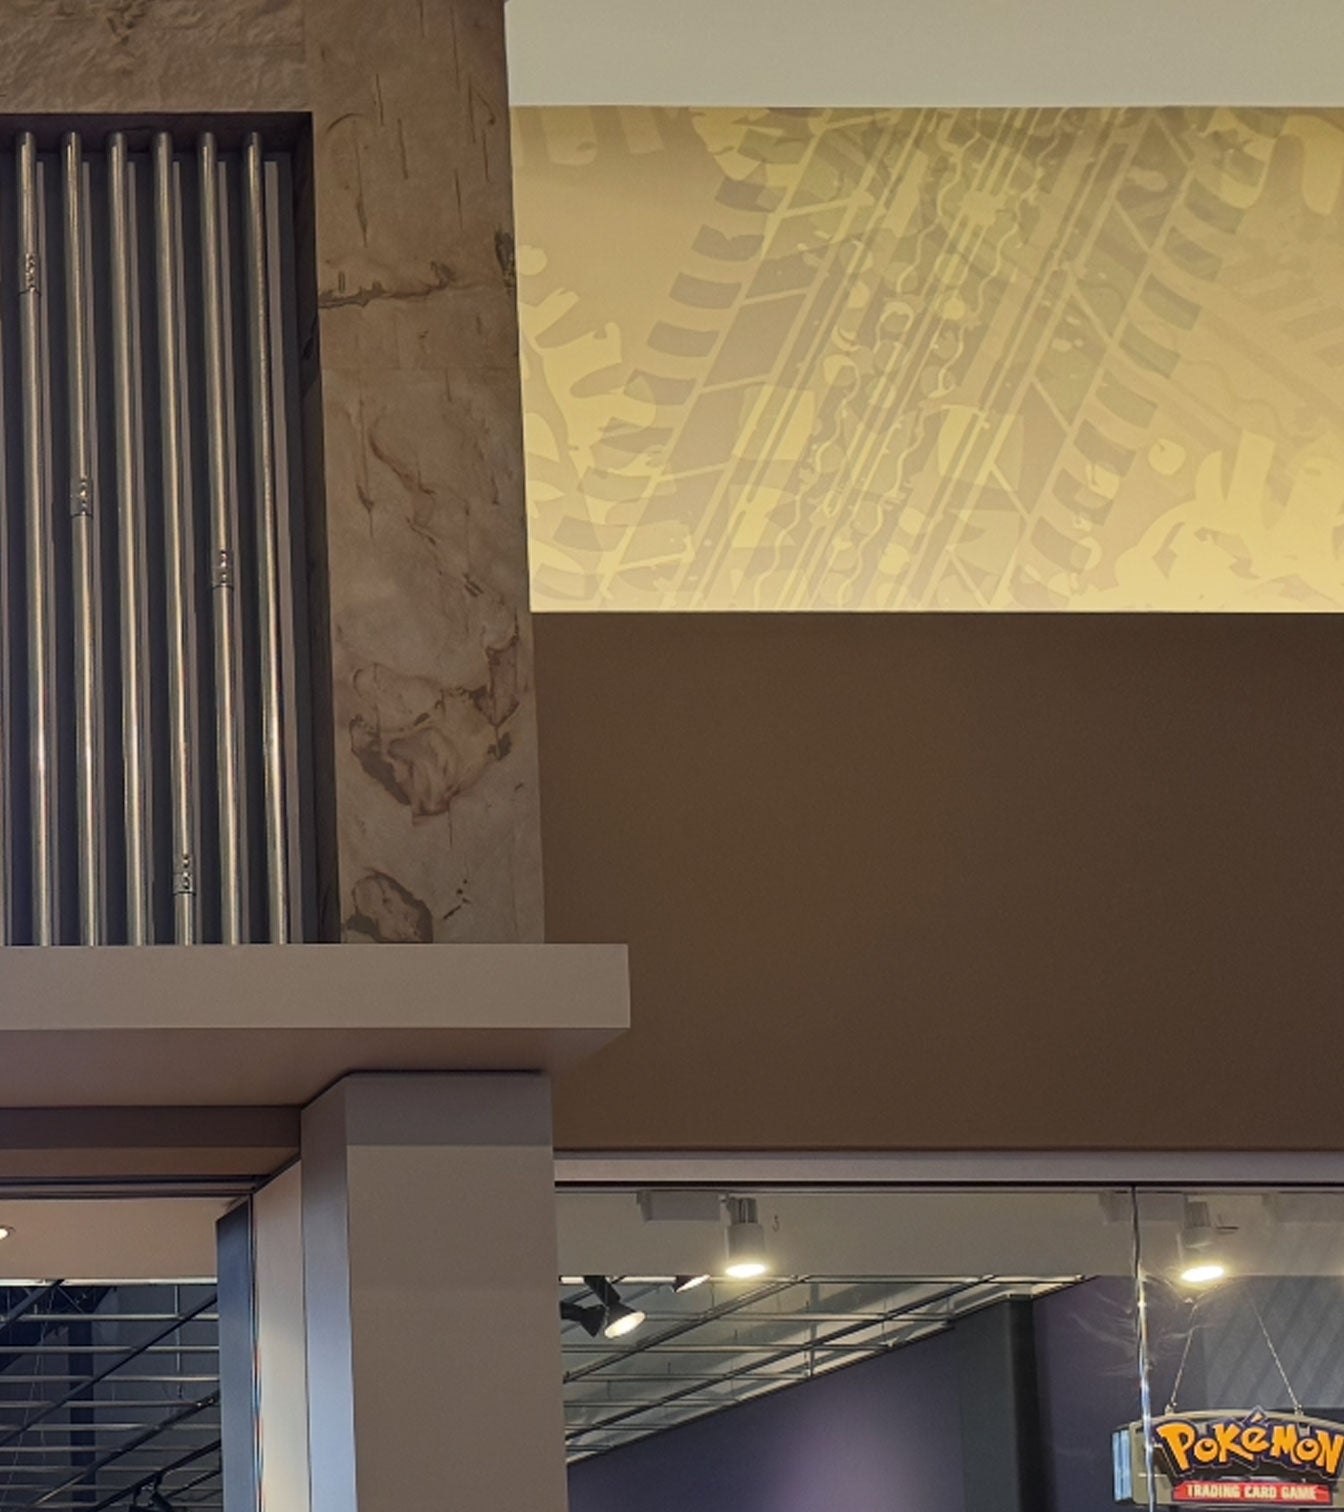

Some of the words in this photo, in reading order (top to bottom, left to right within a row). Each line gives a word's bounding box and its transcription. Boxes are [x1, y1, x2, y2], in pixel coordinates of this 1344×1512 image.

[1186, 1483, 1241, 1499] TRADING
[1243, 1483, 1278, 1499] CARD
[1280, 1483, 1317, 1501] GAME
